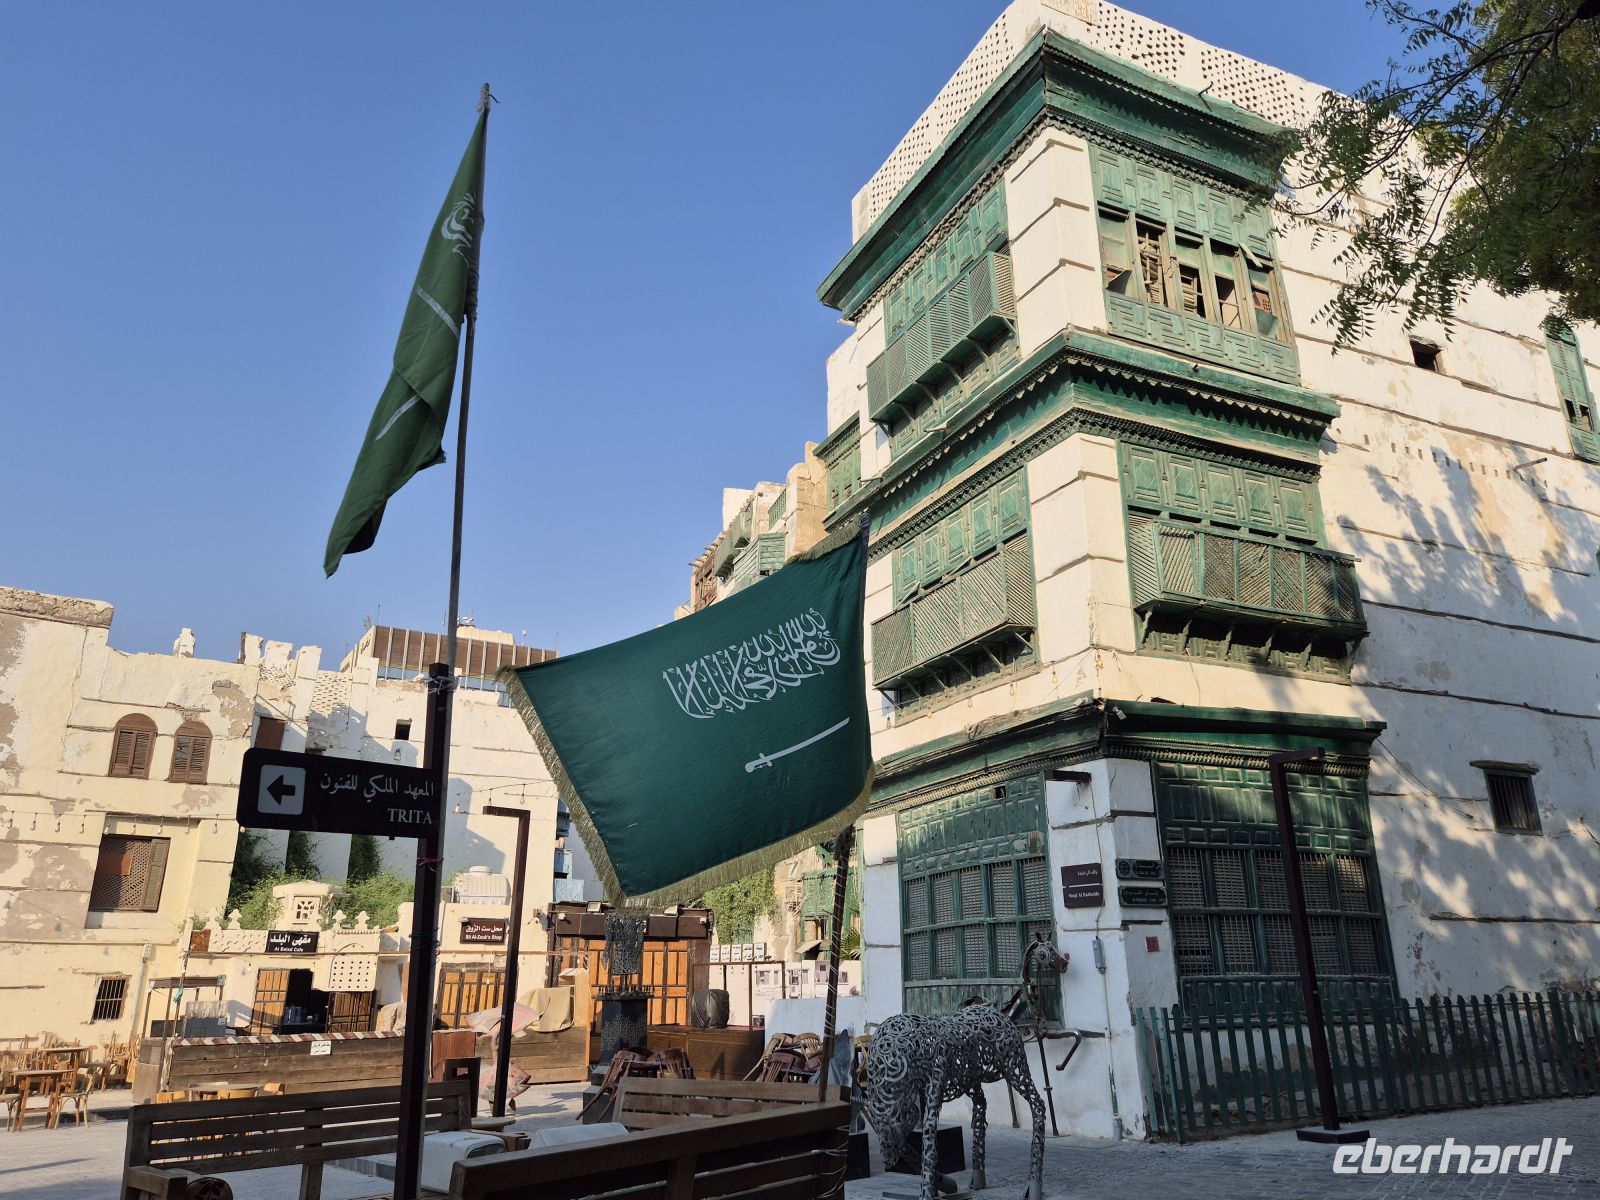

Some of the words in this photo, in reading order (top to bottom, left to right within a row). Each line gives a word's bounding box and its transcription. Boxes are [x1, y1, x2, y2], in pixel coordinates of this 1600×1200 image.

[320, 772, 358, 796] للفنون
[364, 775, 398, 803] الملكي
[404, 781, 434, 801] المعهد
[388, 808, 433, 825] TRITA
[491, 925, 503, 933] محل
[270, 933, 291, 946] البلد
[291, 934, 312, 946] مقهى
